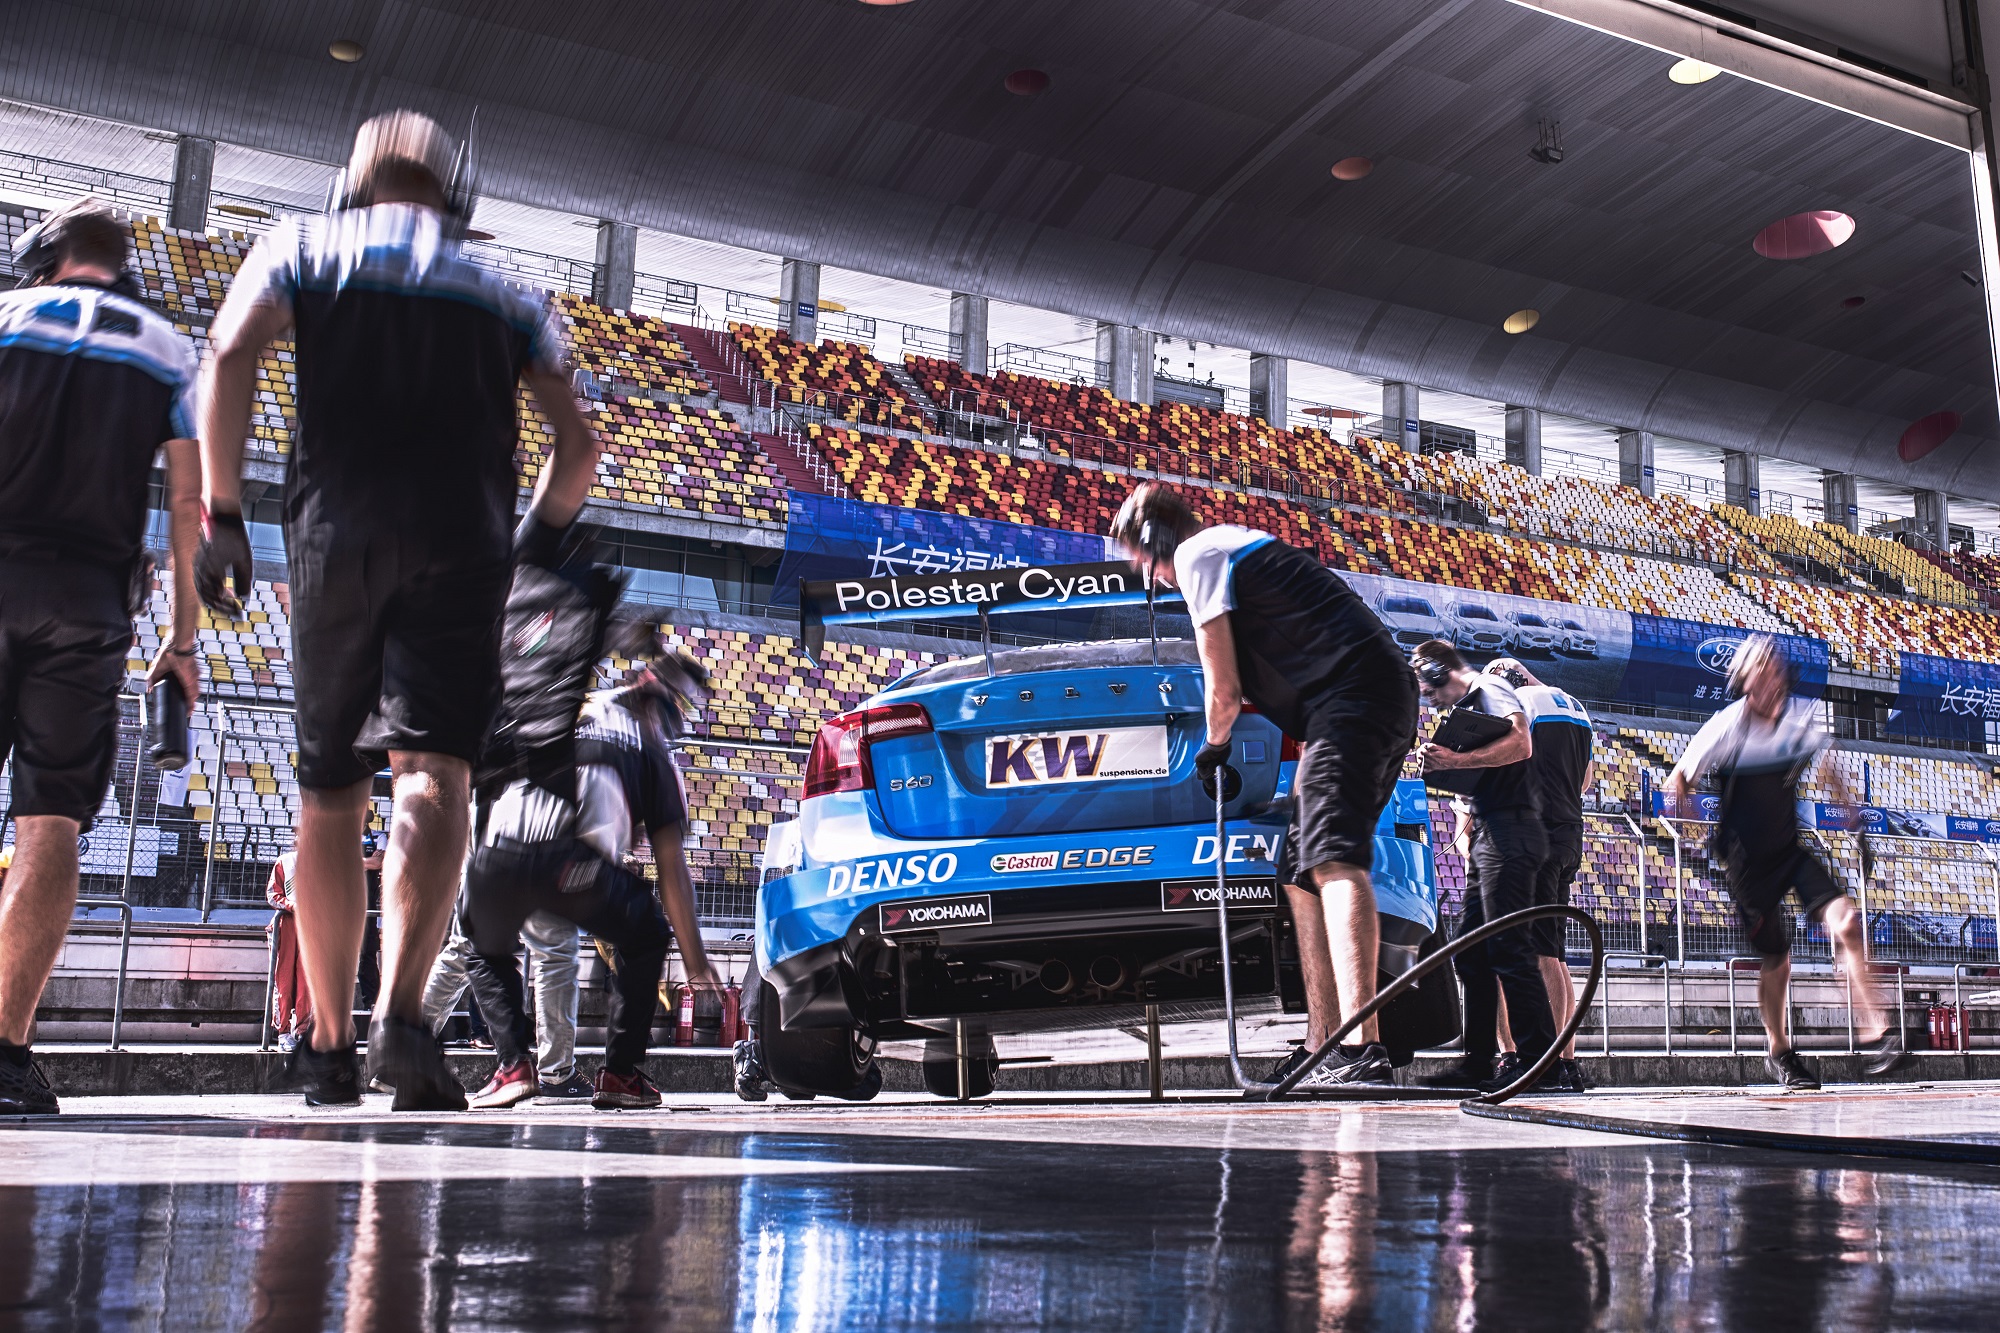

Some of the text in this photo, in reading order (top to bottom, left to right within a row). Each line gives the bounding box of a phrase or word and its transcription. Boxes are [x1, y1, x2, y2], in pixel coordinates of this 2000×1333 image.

[835, 578, 1004, 612] Polestar
[1018, 567, 1125, 603] Cyan
[971, 682, 1173, 707] VOLVO
[989, 733, 1110, 785] KW
[890, 774, 934, 792] S60
[1099, 767, 1168, 783] suspensions.de
[1007, 844, 1157, 870] Castrol EDGE
[1191, 834, 1280, 865] DEN
[827, 852, 958, 898] DENSO
[1192, 886, 1272, 902] YOKOHAMA
[907, 903, 986, 923] YOKOHAMA
